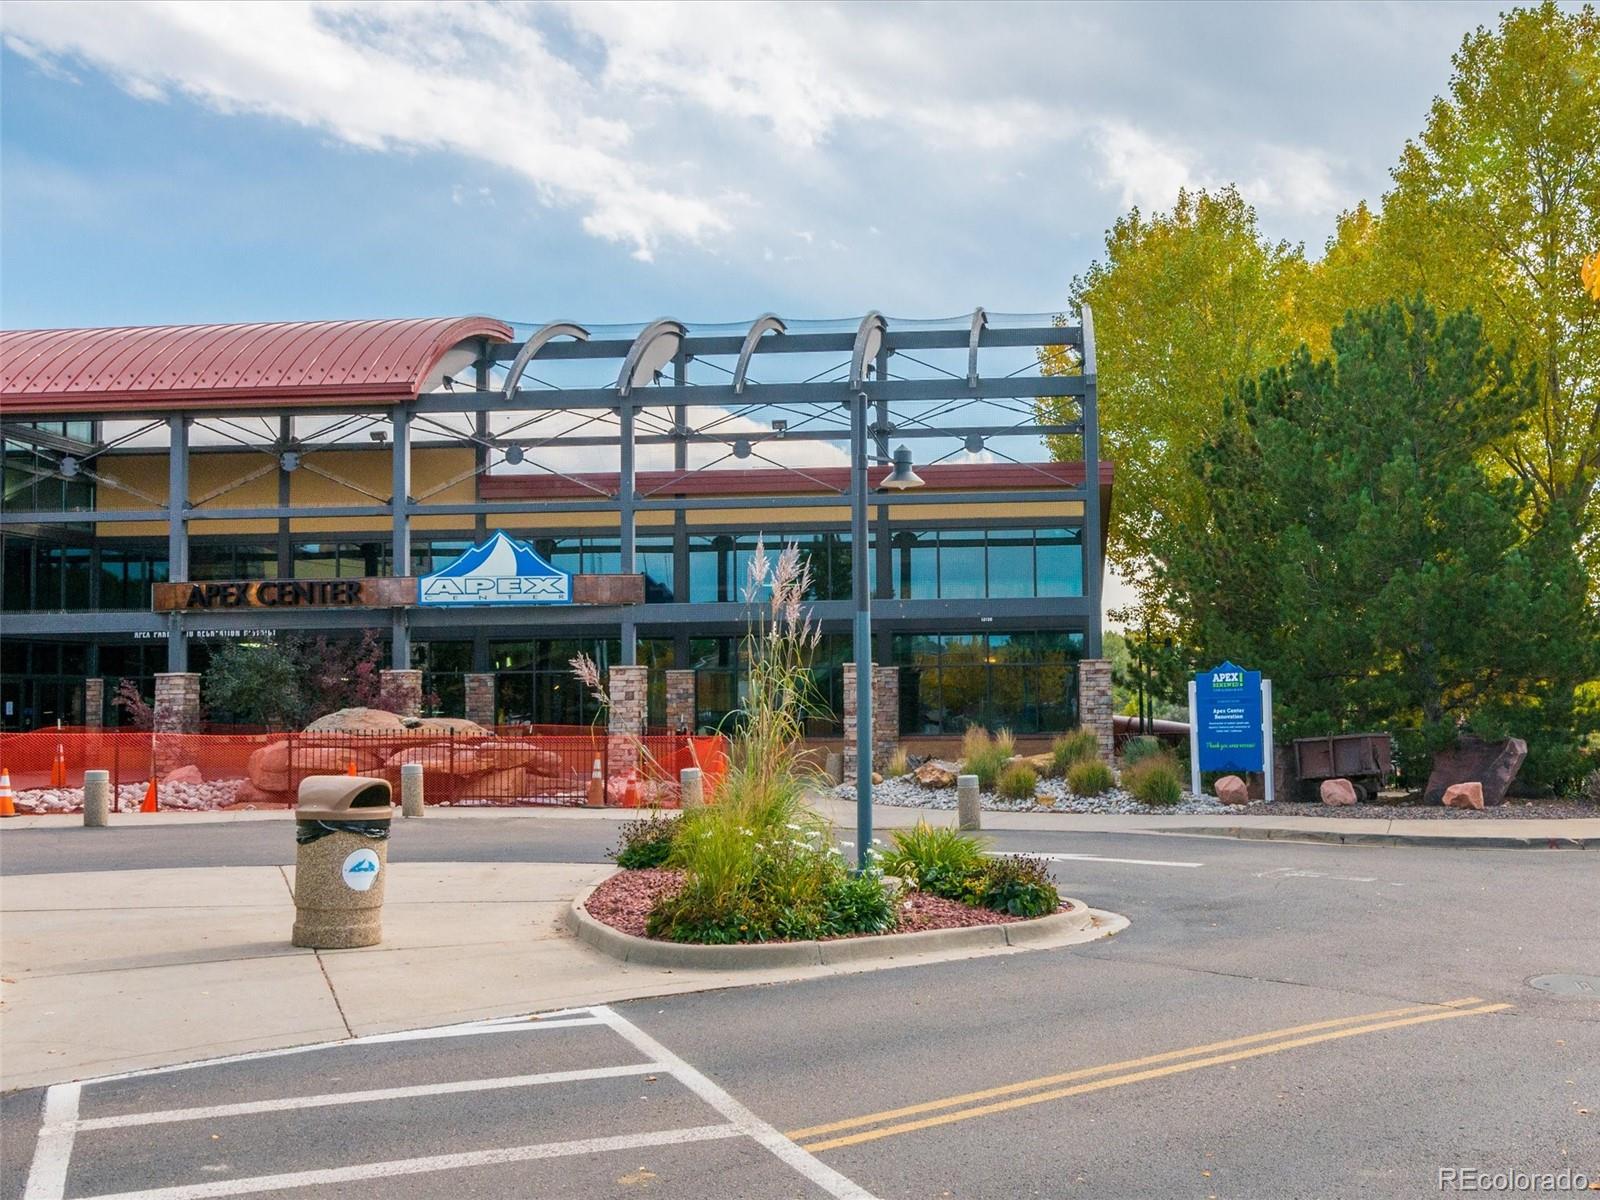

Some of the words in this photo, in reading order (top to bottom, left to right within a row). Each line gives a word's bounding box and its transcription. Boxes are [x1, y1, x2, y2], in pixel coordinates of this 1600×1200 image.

[186, 583, 250, 607] APEX
[256, 582, 362, 605] CENTER
[424, 577, 565, 594] APEX
